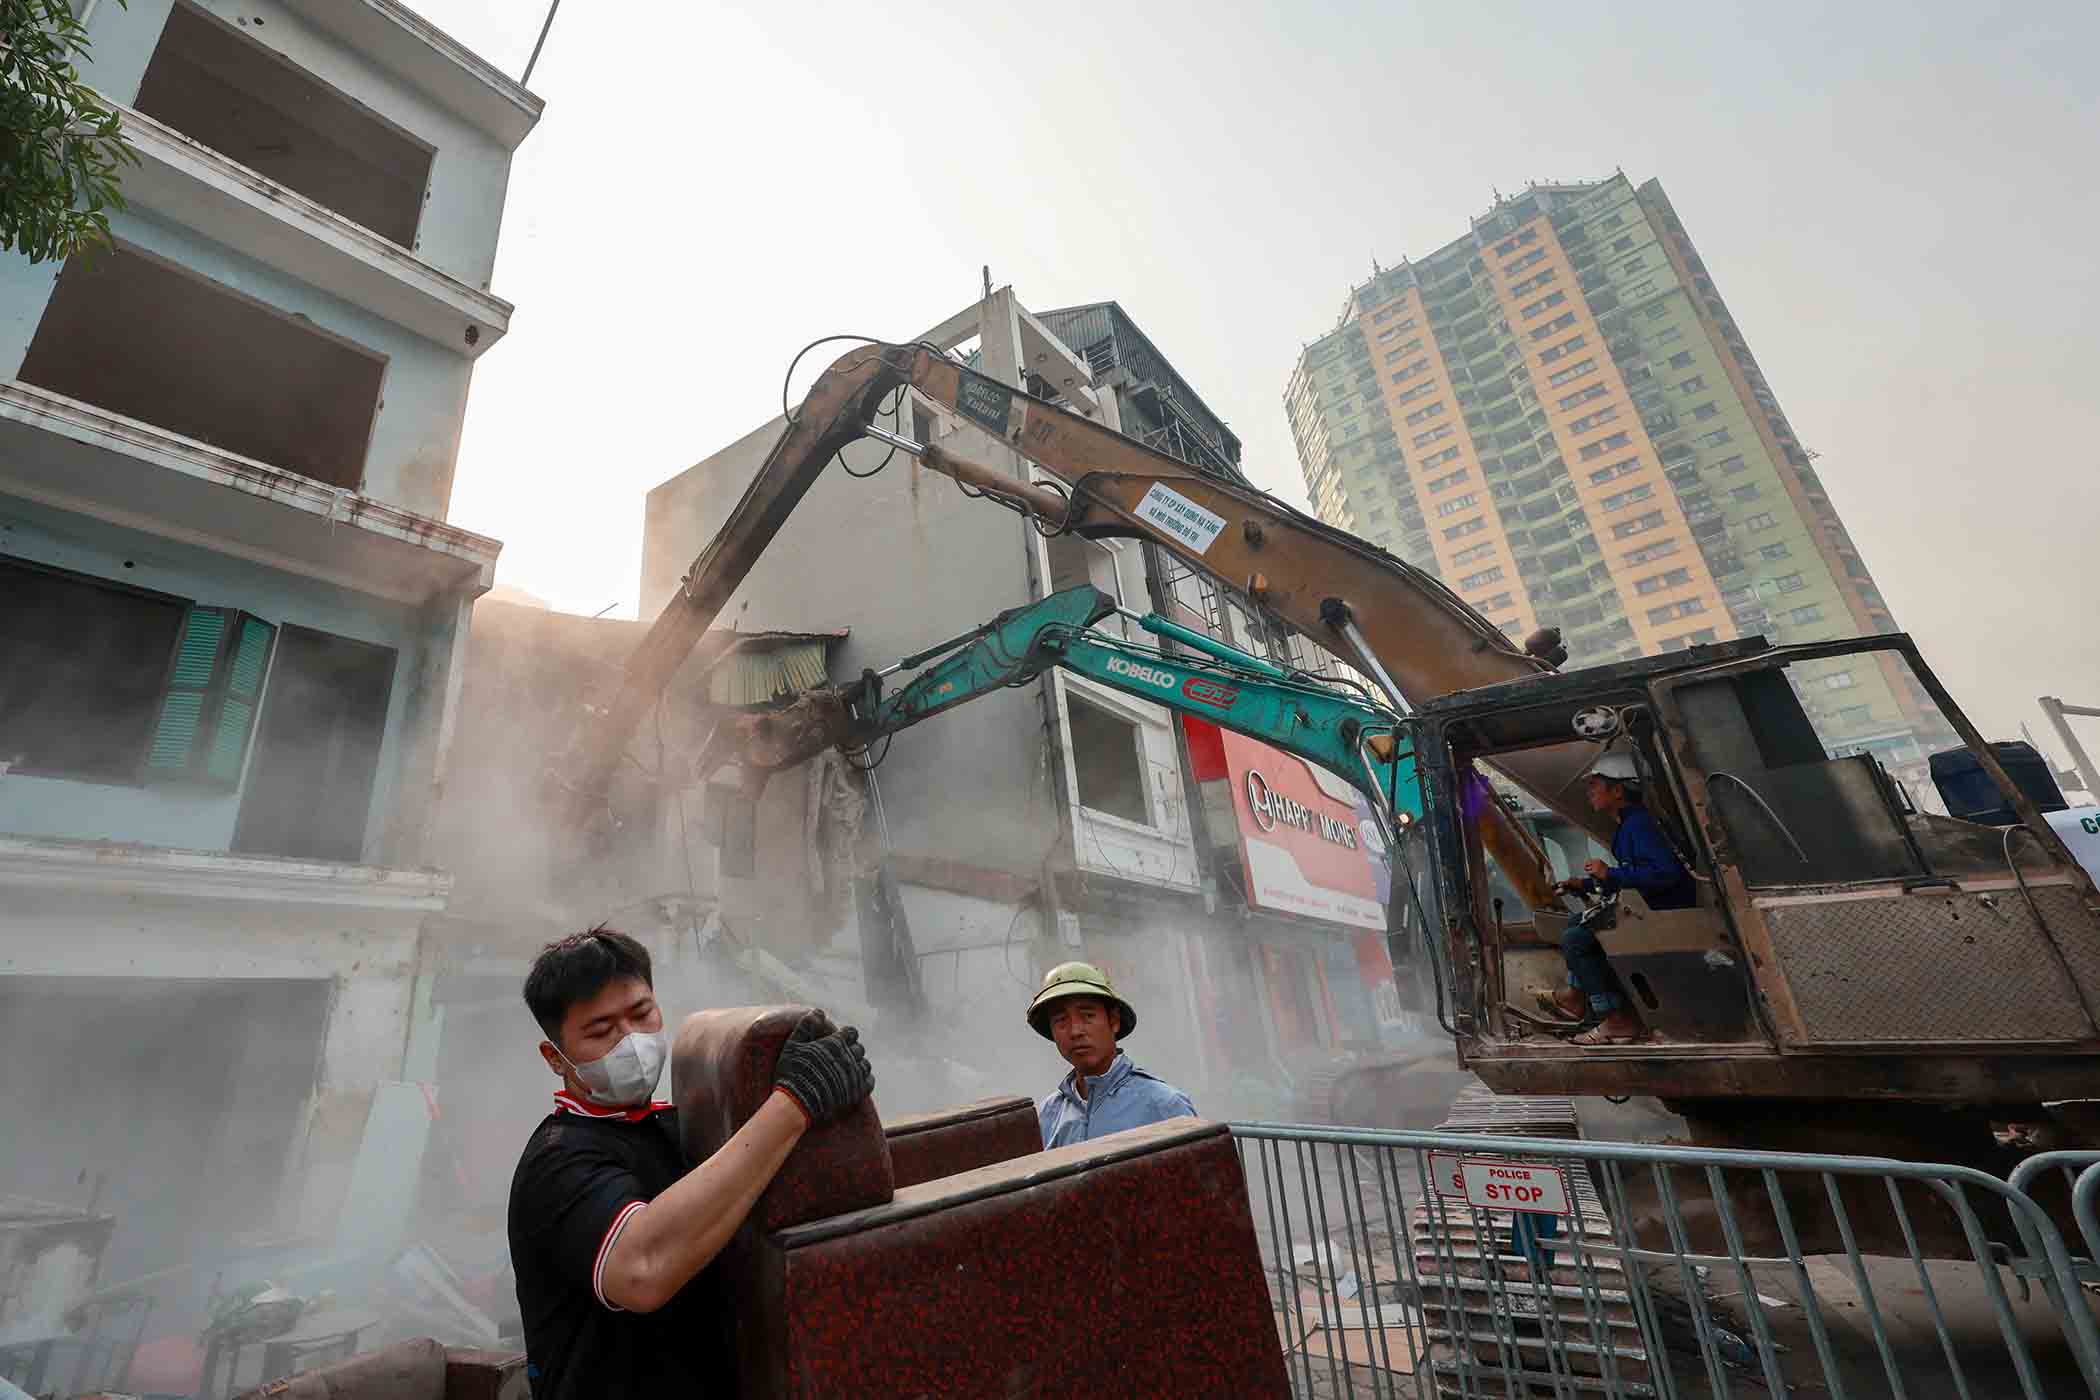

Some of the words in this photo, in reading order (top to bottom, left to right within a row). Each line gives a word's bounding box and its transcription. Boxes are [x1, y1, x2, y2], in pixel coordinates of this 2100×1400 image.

[1106, 655, 1176, 689] KOBELCO
[1275, 791, 1313, 833] HAPPY
[1319, 813, 1357, 849] MONEY
[1489, 1168, 1531, 1181] POLICE
[1486, 1183, 1544, 1202] STOP
